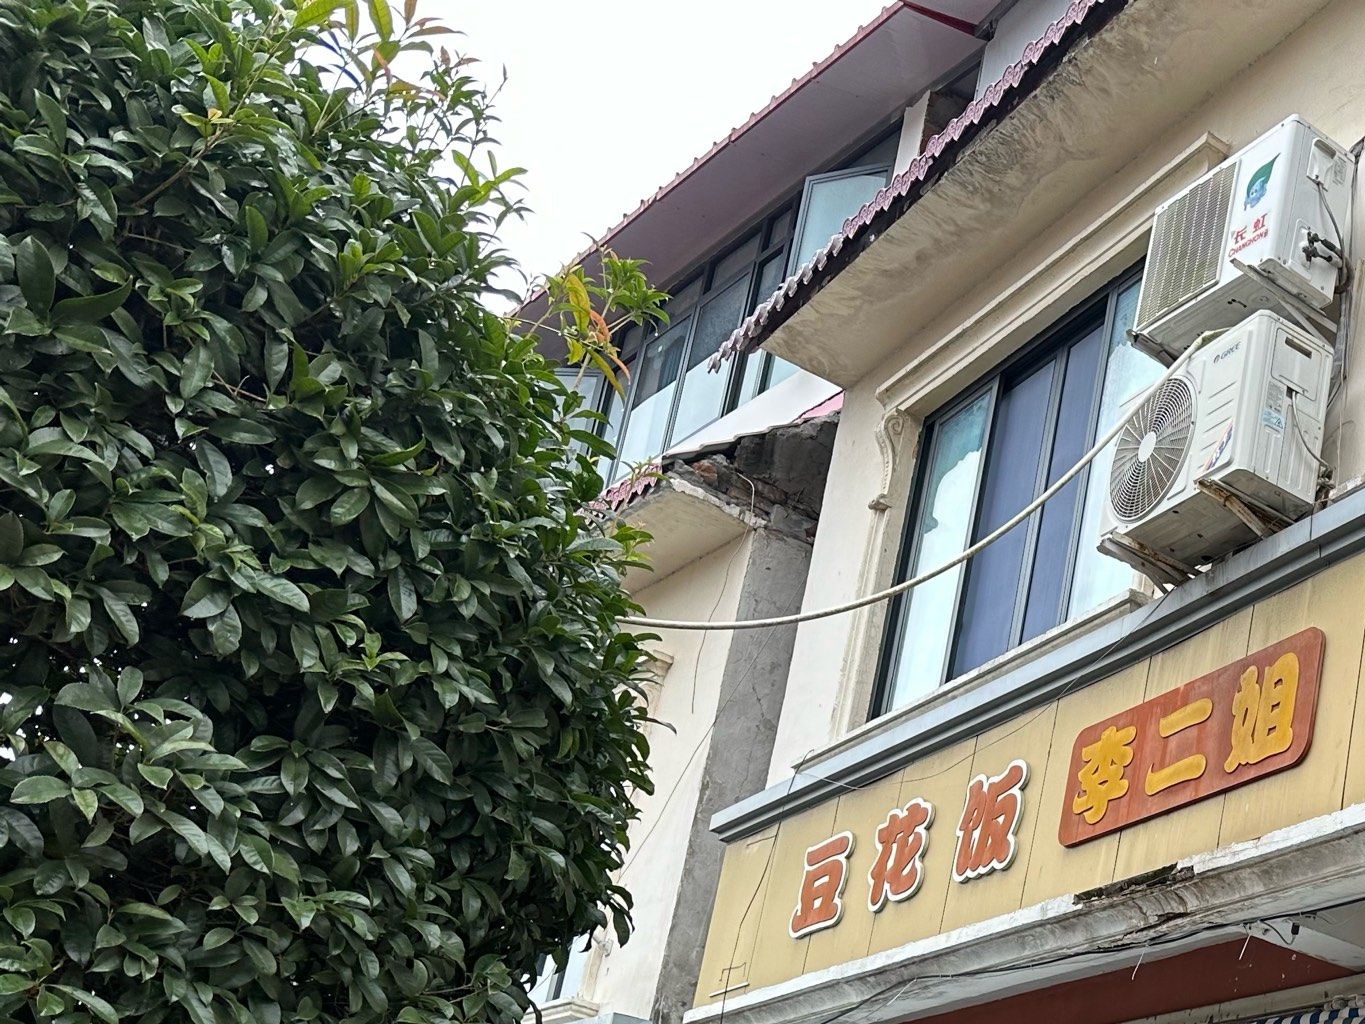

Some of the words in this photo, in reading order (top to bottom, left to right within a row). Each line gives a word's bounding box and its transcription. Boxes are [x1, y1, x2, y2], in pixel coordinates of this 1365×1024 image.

[1233, 213, 1268, 245] 长虹
[1072, 652, 1300, 825] 李二姐
[789, 759, 1030, 938] 豆花饭
